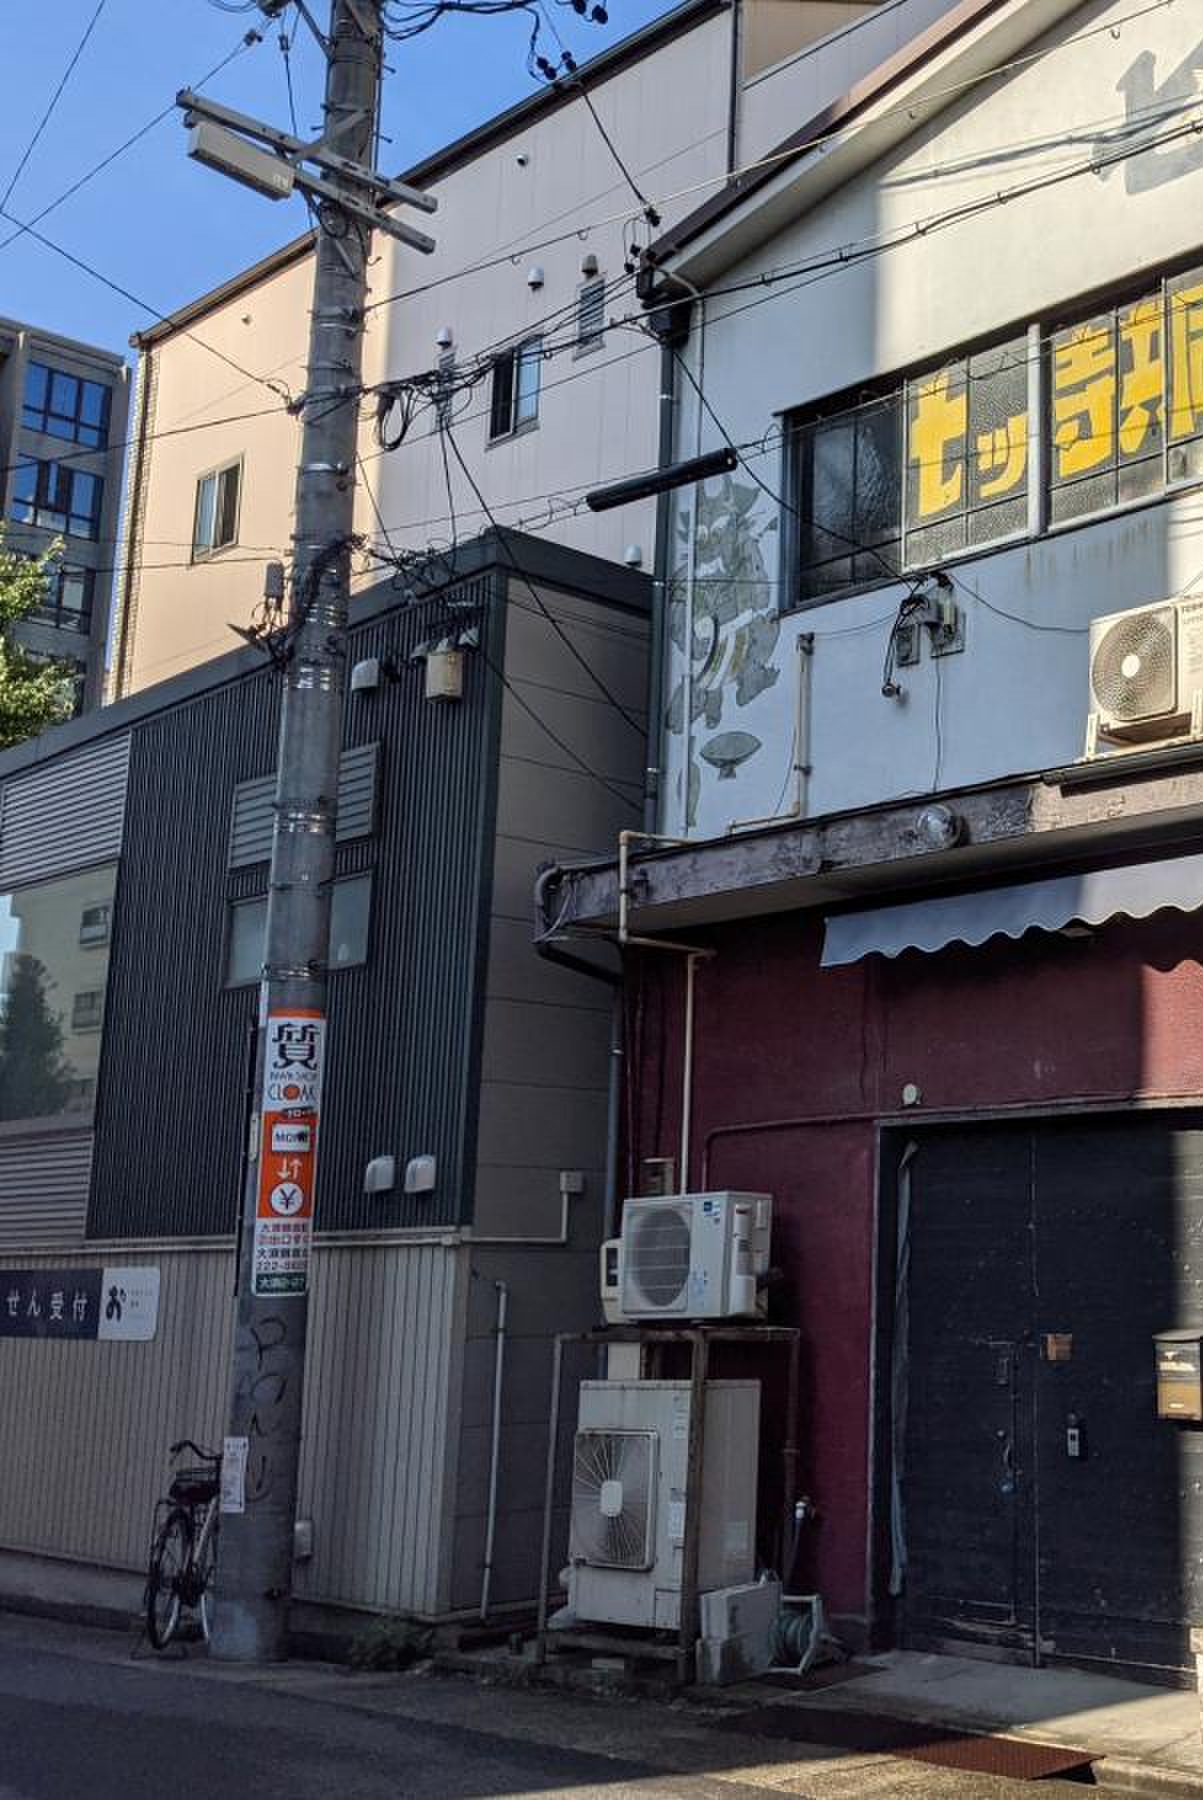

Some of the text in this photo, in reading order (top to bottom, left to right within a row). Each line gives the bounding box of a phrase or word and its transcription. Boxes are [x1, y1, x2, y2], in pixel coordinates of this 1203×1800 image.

[272, 1023, 321, 1069] 質
[7, 1288, 88, 1322] せん受付
